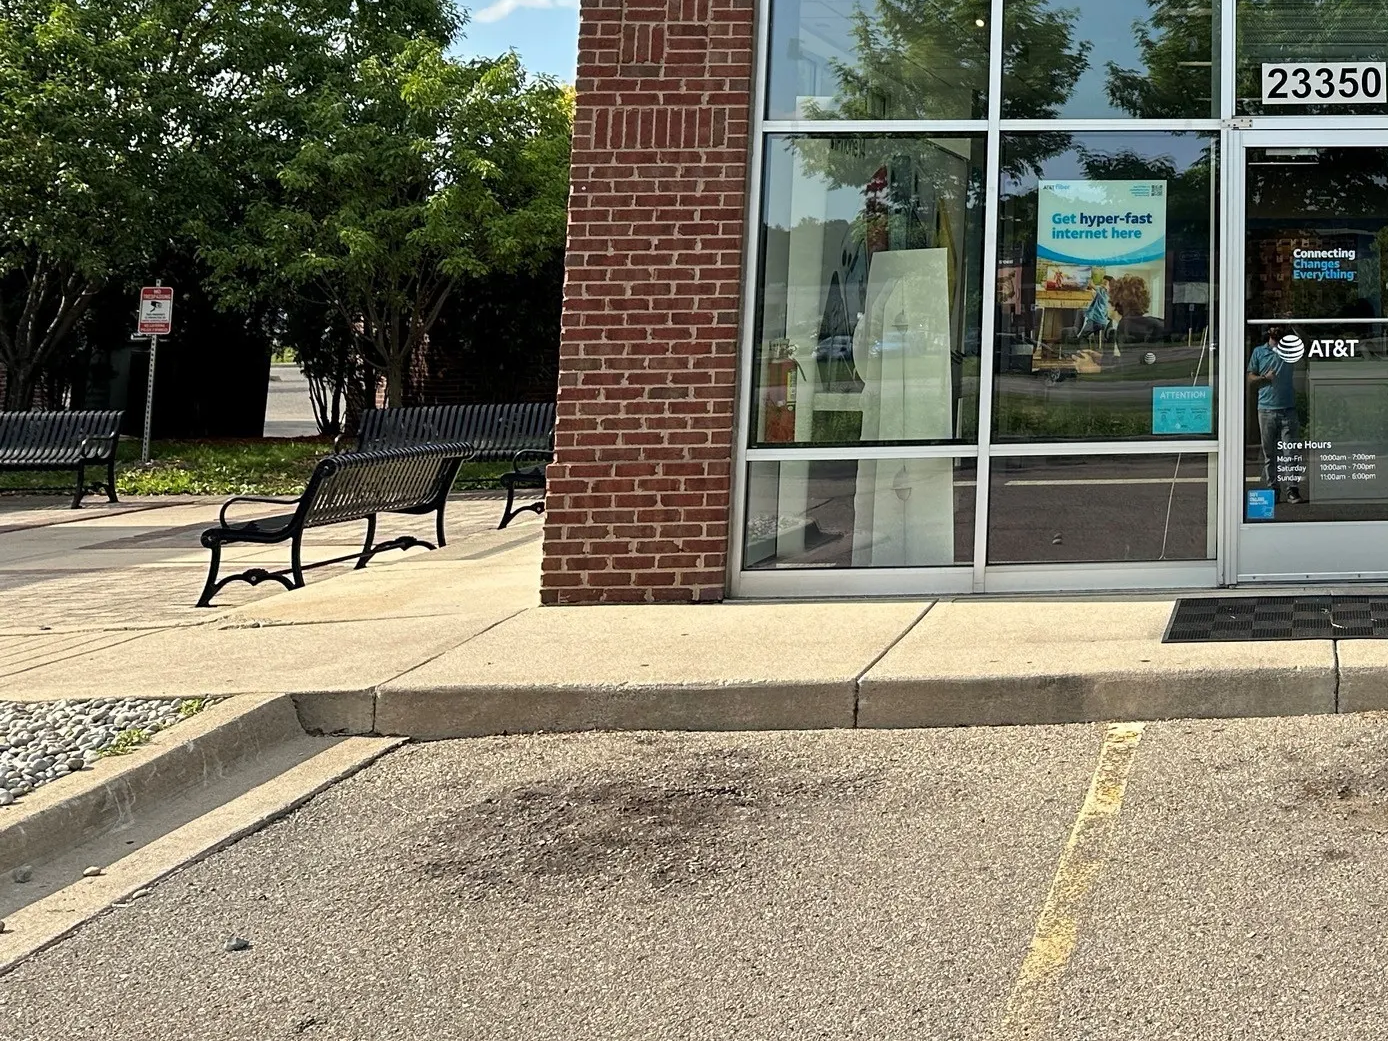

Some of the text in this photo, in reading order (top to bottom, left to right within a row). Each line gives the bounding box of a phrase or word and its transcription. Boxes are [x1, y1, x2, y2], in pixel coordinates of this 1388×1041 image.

[1267, 67, 1382, 98] 23350
[1052, 212, 1153, 227] Get hyper-fast
[1052, 227, 1142, 239] internet here
[1293, 248, 1356, 260] Connecting
[1293, 259, 1340, 270] Changes
[1308, 339, 1359, 357] AT&T
[1160, 391, 1206, 399] ATTENTION
[1277, 441, 1332, 450] Store Hours
[1352, 453, 1376, 461] 7:00pm
[1277, 464, 1306, 473] Saturday
[1320, 463, 1347, 471] 10:00am
[1352, 463, 1376, 471] 7:00pm
[1277, 474, 1301, 482] Sunday
